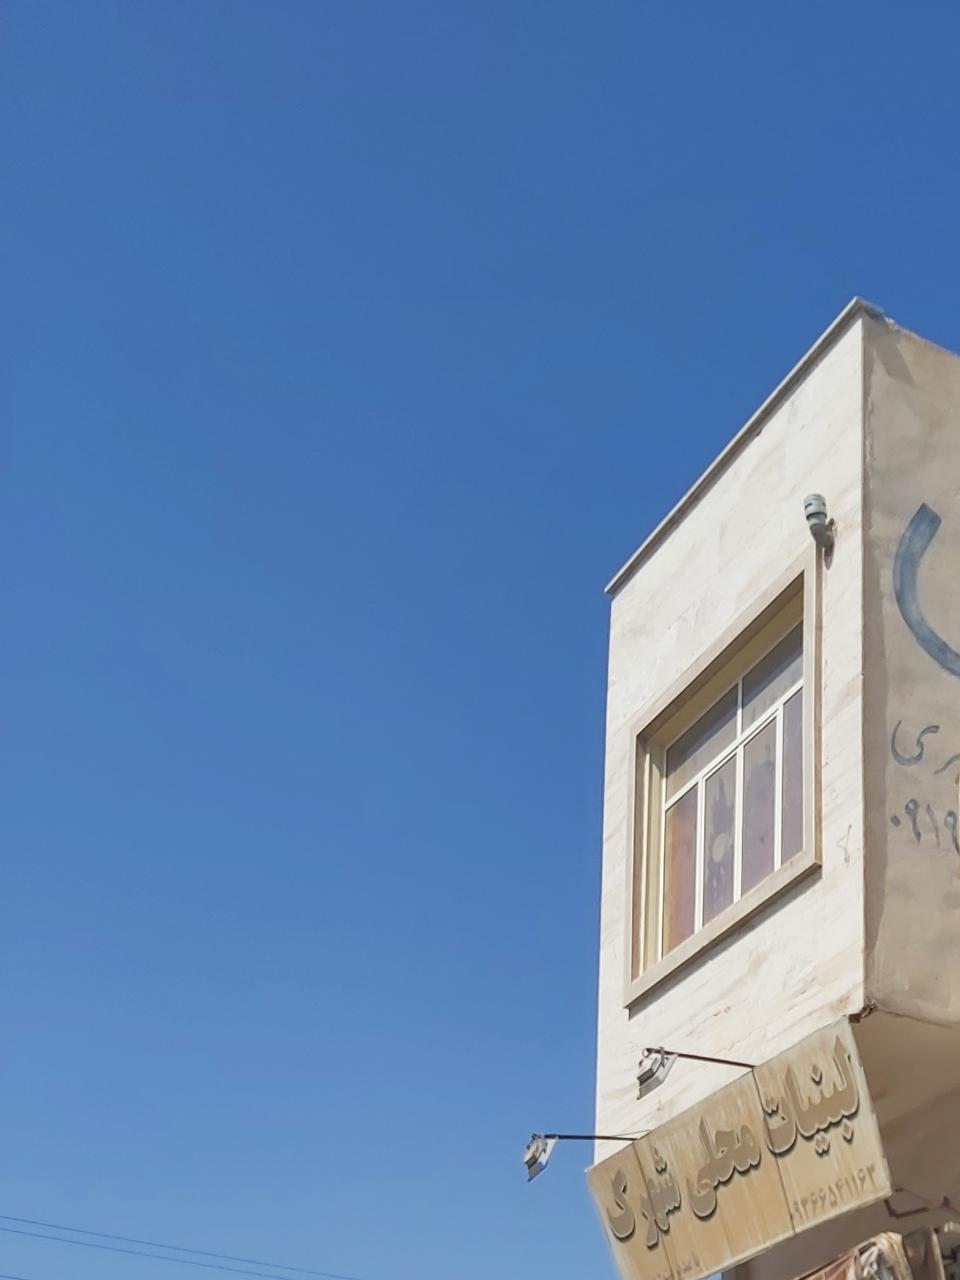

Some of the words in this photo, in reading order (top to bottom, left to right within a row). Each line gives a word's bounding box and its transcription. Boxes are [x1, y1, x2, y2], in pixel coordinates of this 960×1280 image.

[762, 1035, 861, 1157] لبنیات
[605, 1149, 683, 1249] شهرک
[686, 1114, 762, 1221] محلی
